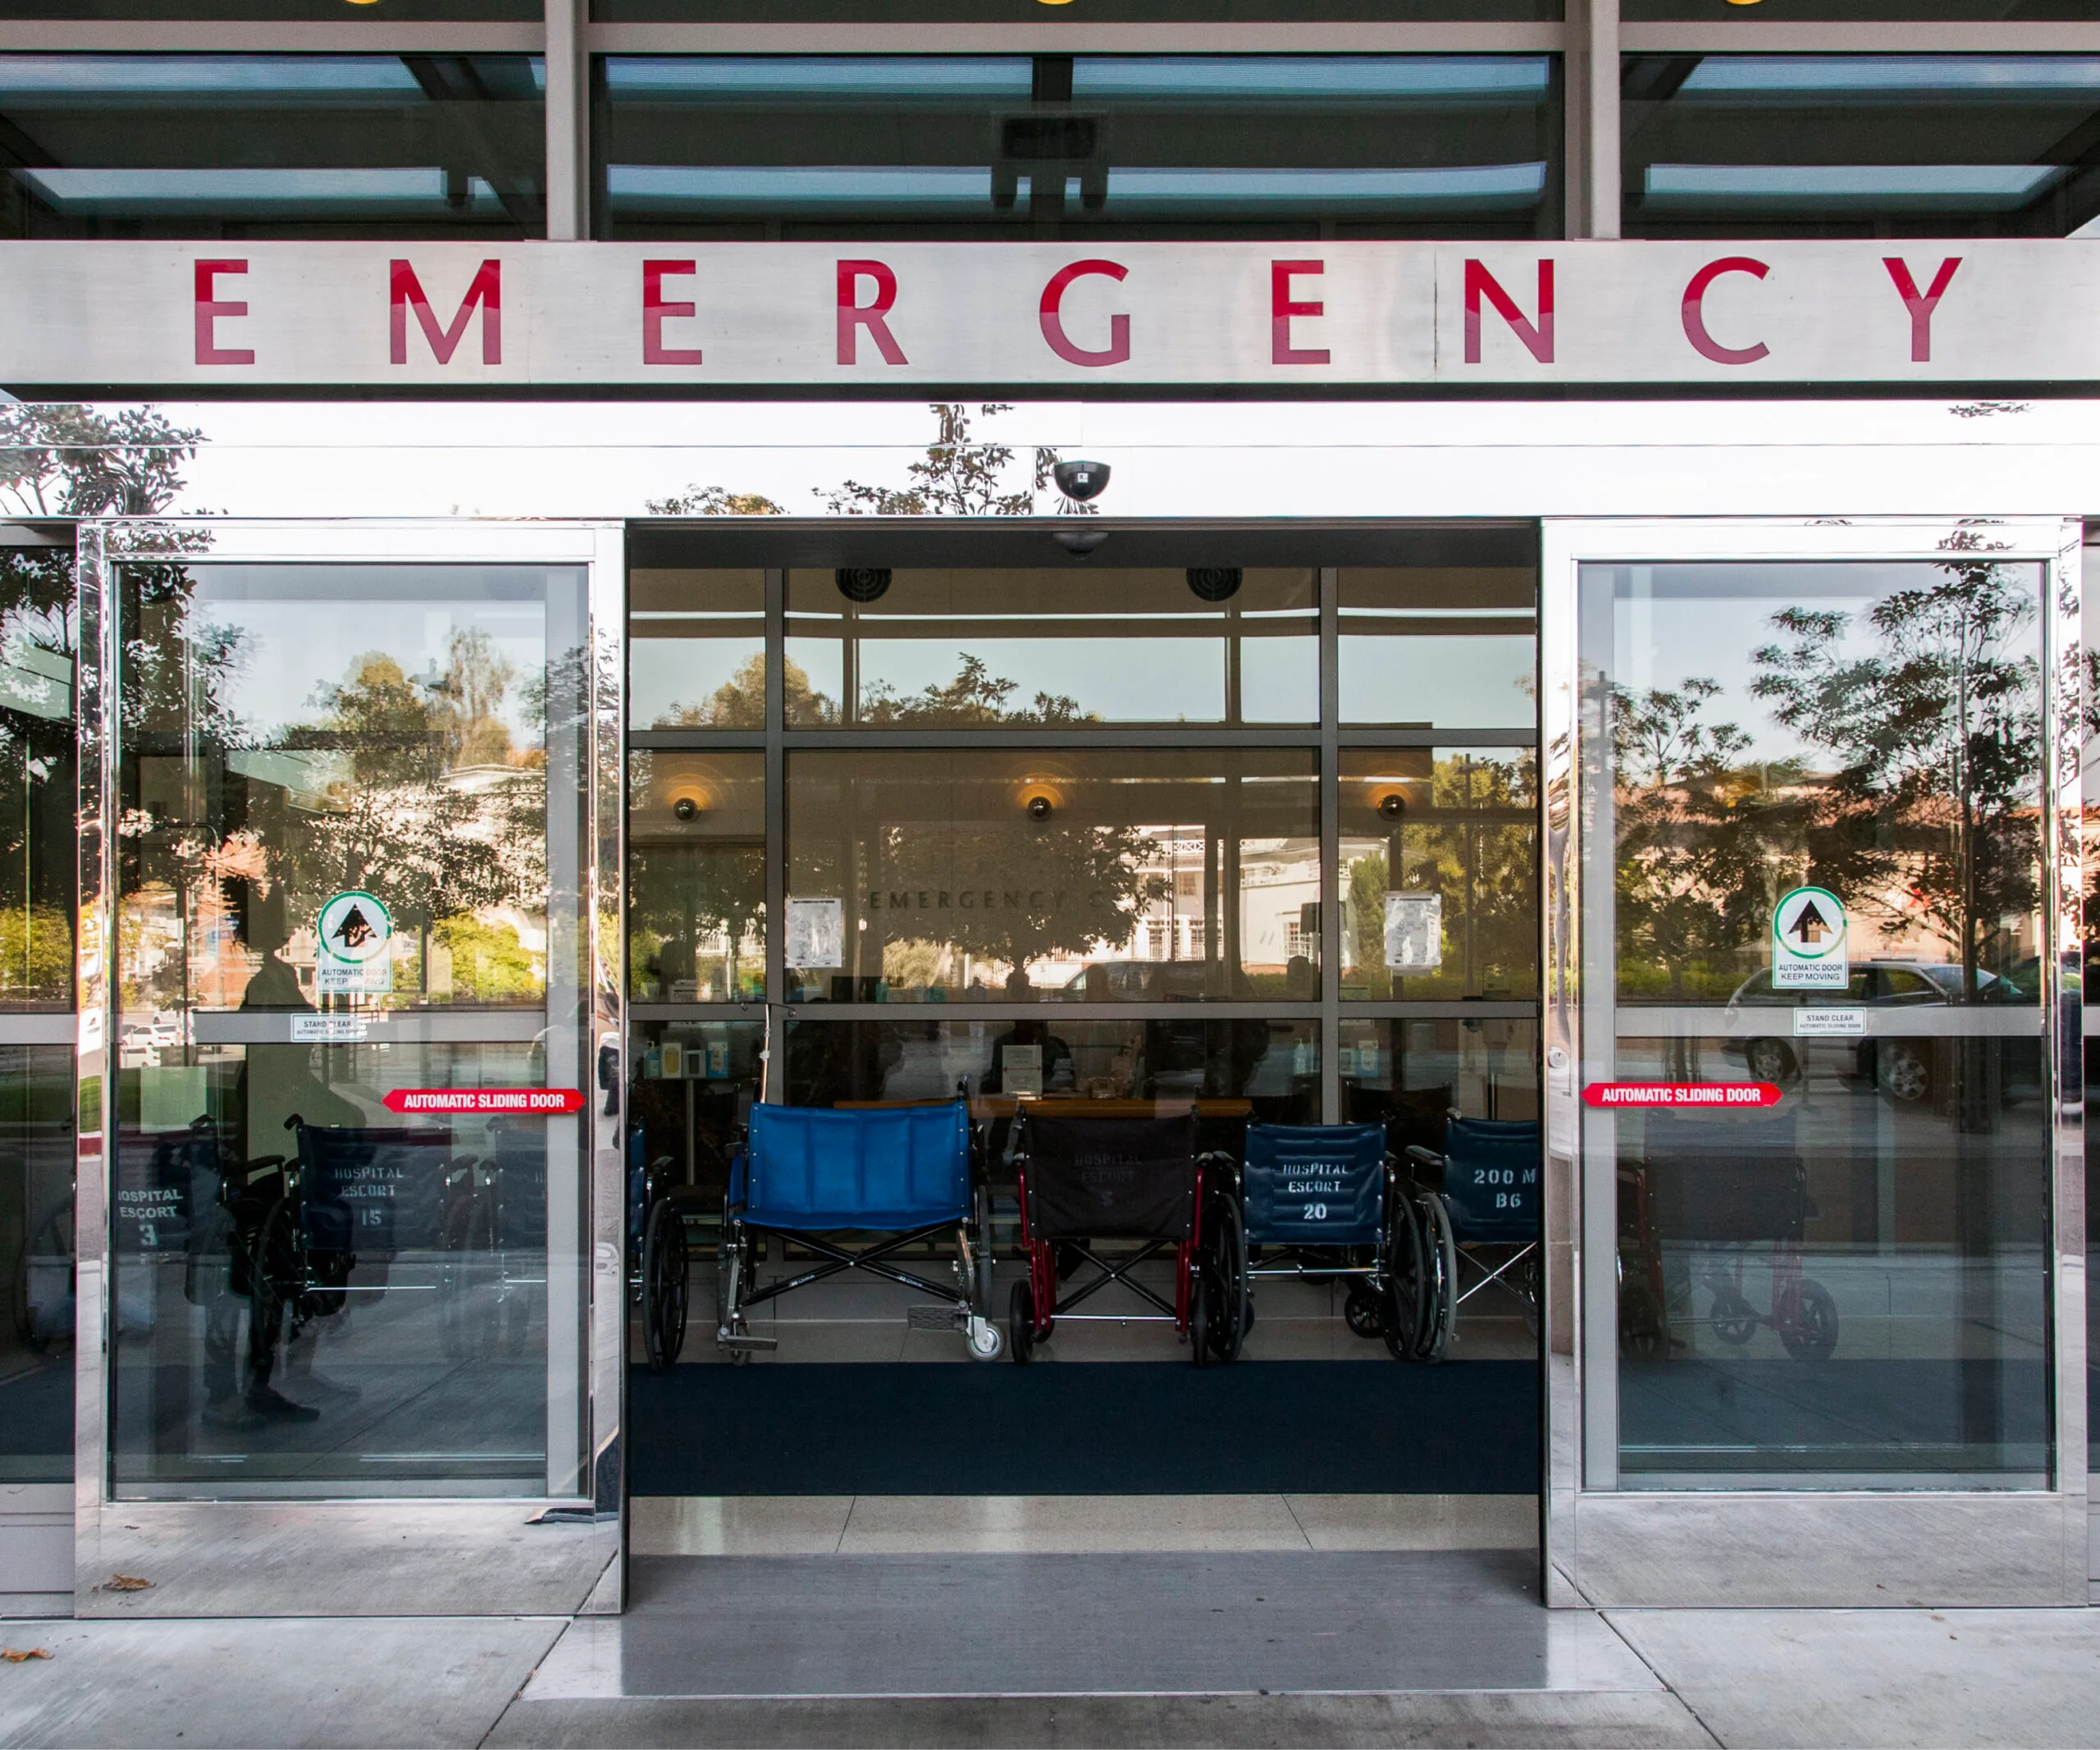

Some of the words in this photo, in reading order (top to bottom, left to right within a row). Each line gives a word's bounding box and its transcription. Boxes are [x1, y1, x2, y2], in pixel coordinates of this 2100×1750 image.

[194, 257, 1963, 367] EMERGENCY
[869, 891, 1065, 909] EMERGENCY
[325, 977, 348, 985] KEEP
[404, 1094, 476, 1108] AUTOMATIC
[477, 1094, 527, 1108] SLIDING
[530, 1094, 565, 1108] DOOR
[1601, 1088, 1673, 1103] AUTOMATIC
[1674, 1088, 1724, 1103] SLIDING
[1726, 1088, 1761, 1103] DOOR
[334, 1167, 404, 1180] HOSPITAL
[1283, 1162, 1349, 1175] HOSPITAL
[1473, 1168, 1514, 1185] 200
[341, 1184, 395, 1198] ESCORT
[1288, 1181, 1341, 1194] ESCORT
[1495, 1192, 1522, 1209] B6
[120, 1205, 177, 1219] ESCORT
[362, 1209, 382, 1227] 15
[1303, 1203, 1327, 1220] 20
[139, 1224, 158, 1246] 3
